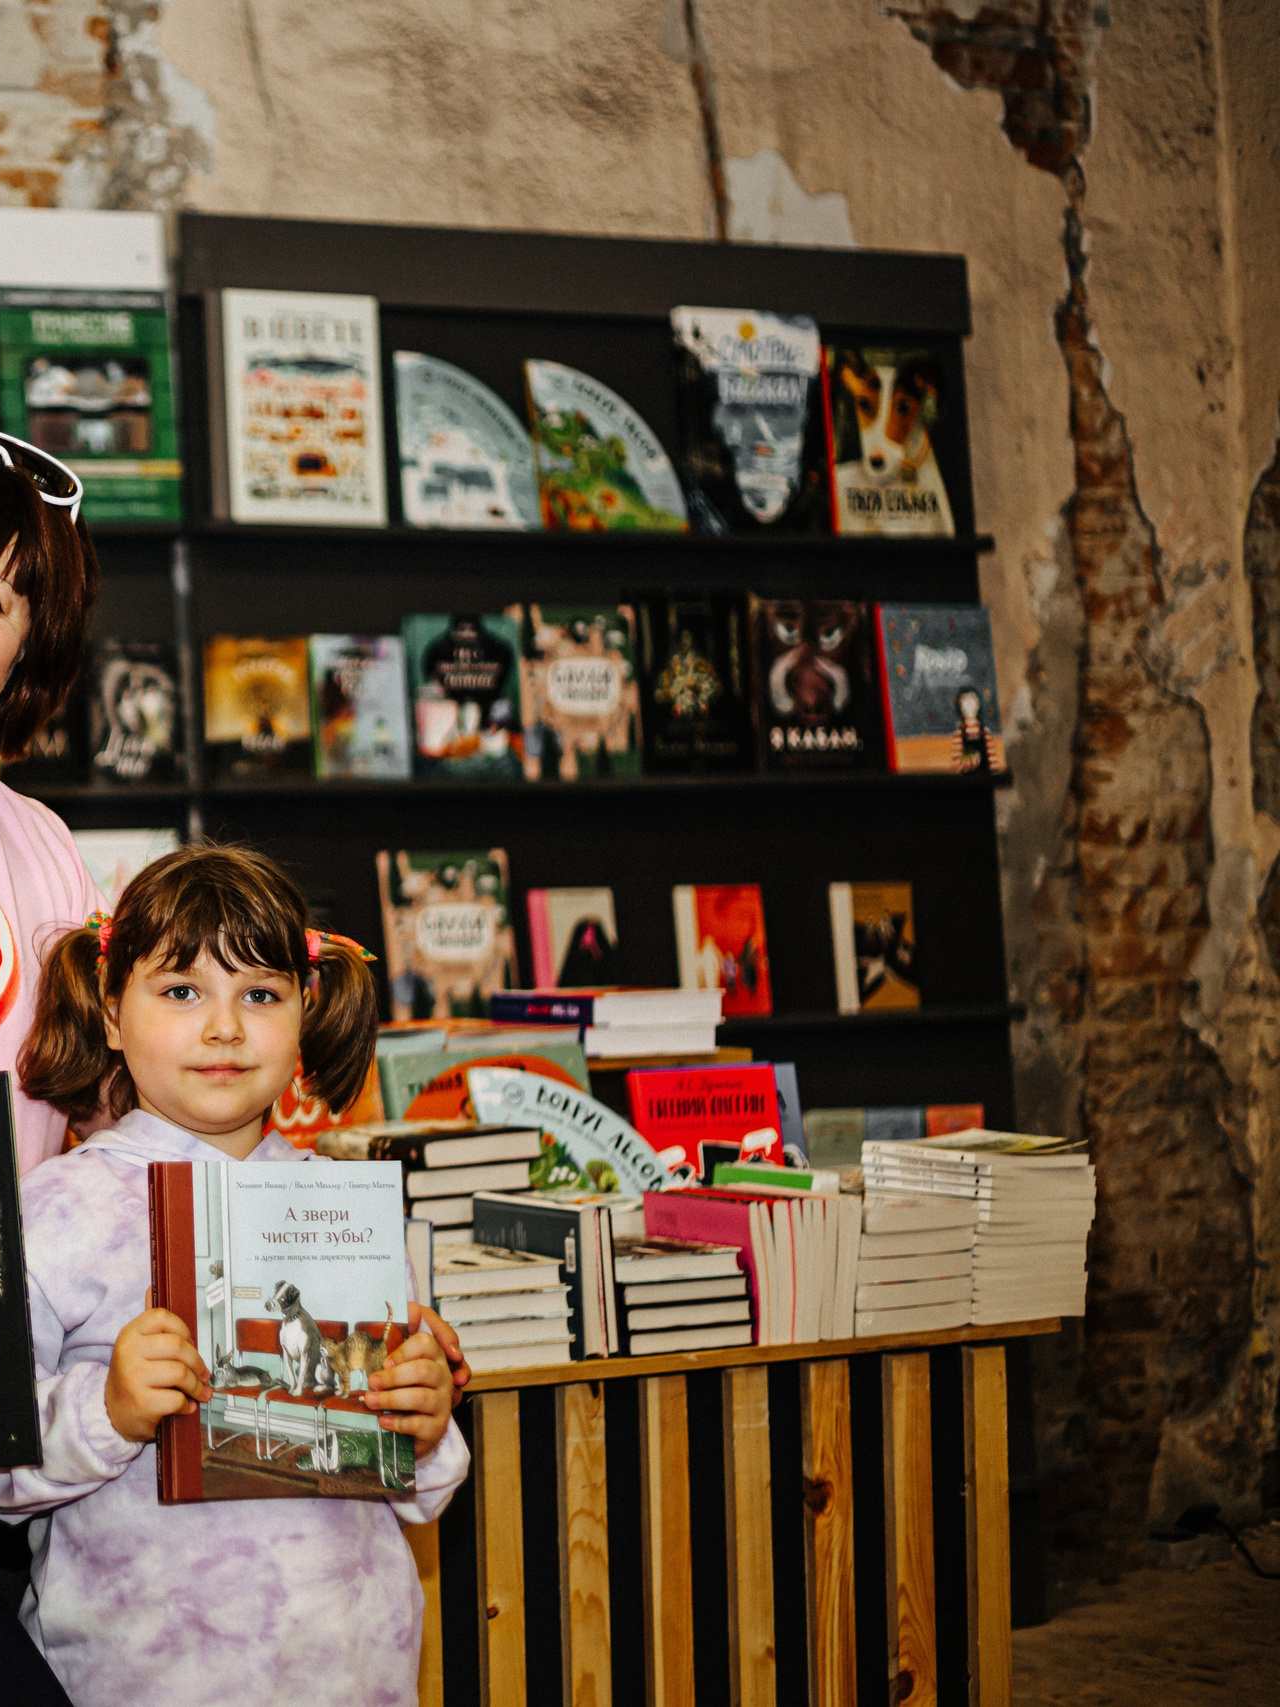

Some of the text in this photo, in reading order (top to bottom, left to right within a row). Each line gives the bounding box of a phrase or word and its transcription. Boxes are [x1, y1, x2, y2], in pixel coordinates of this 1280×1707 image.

[284, 1207, 349, 1225] А звери
[261, 1227, 373, 1247] чистят зубы?
[261, 1254, 286, 1263] другие
[287, 1254, 318, 1263] вопросы
[319, 1254, 356, 1263] директору
[358, 1254, 391, 1262] зоопарка
